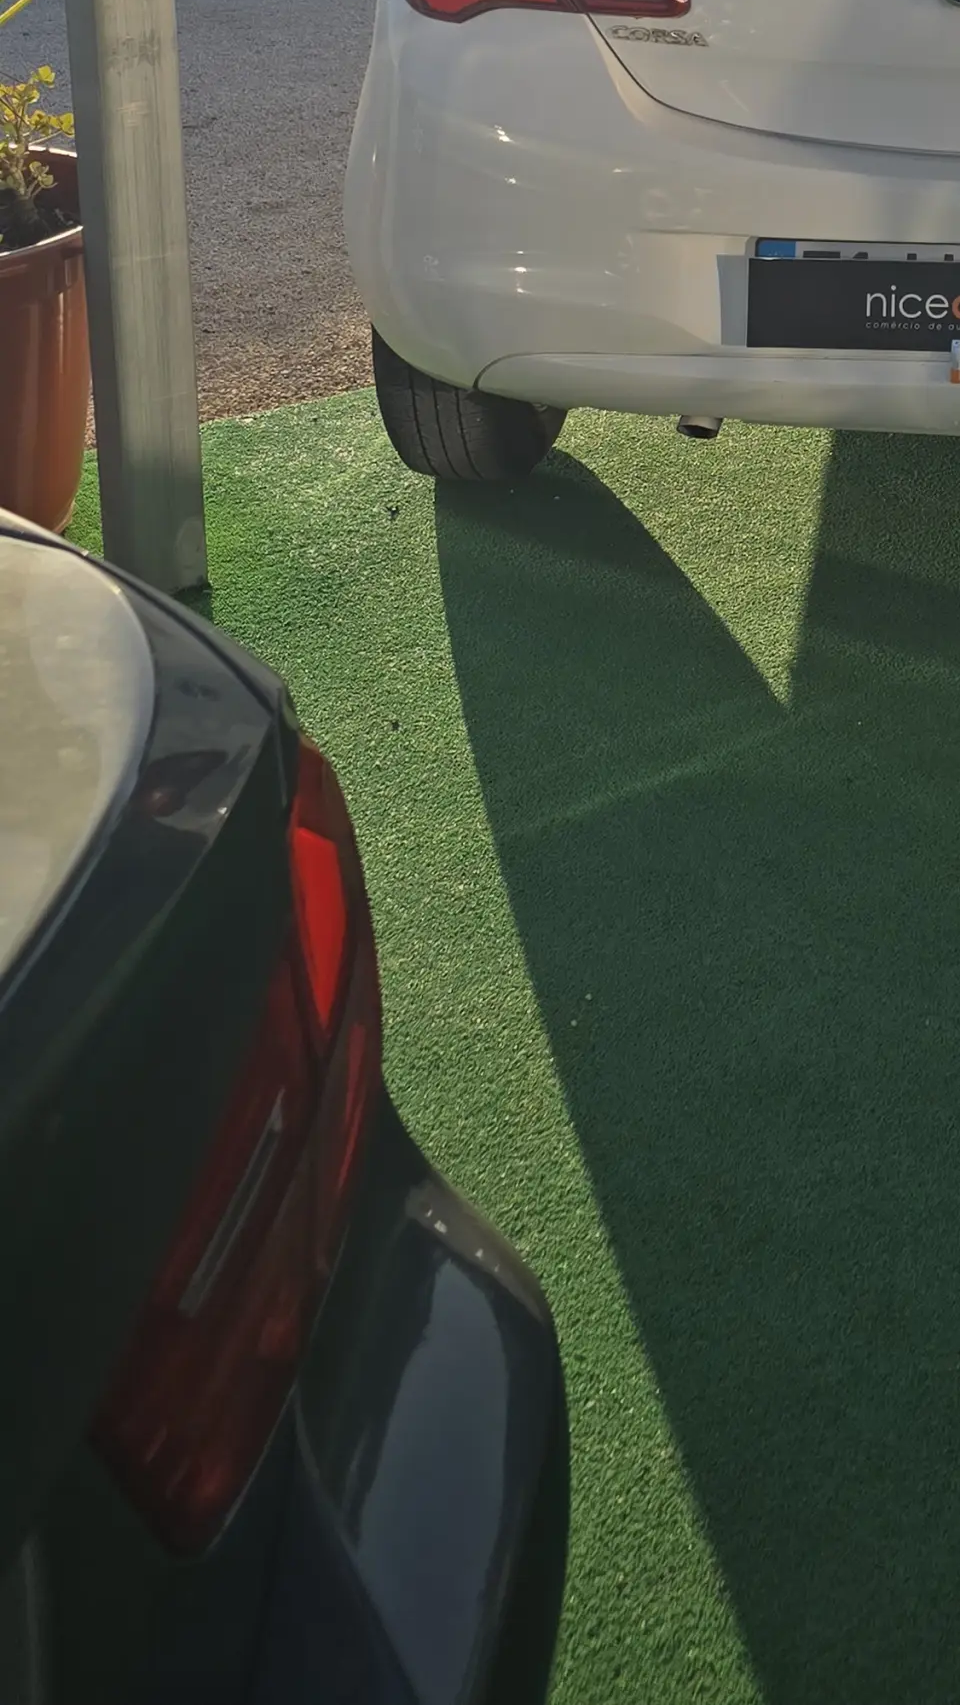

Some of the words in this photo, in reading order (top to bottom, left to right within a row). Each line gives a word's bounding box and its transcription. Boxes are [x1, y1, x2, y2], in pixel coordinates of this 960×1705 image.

[610, 25, 709, 47] CORSA
[865, 319, 921, 331] comércio
[928, 321, 942, 331] de
